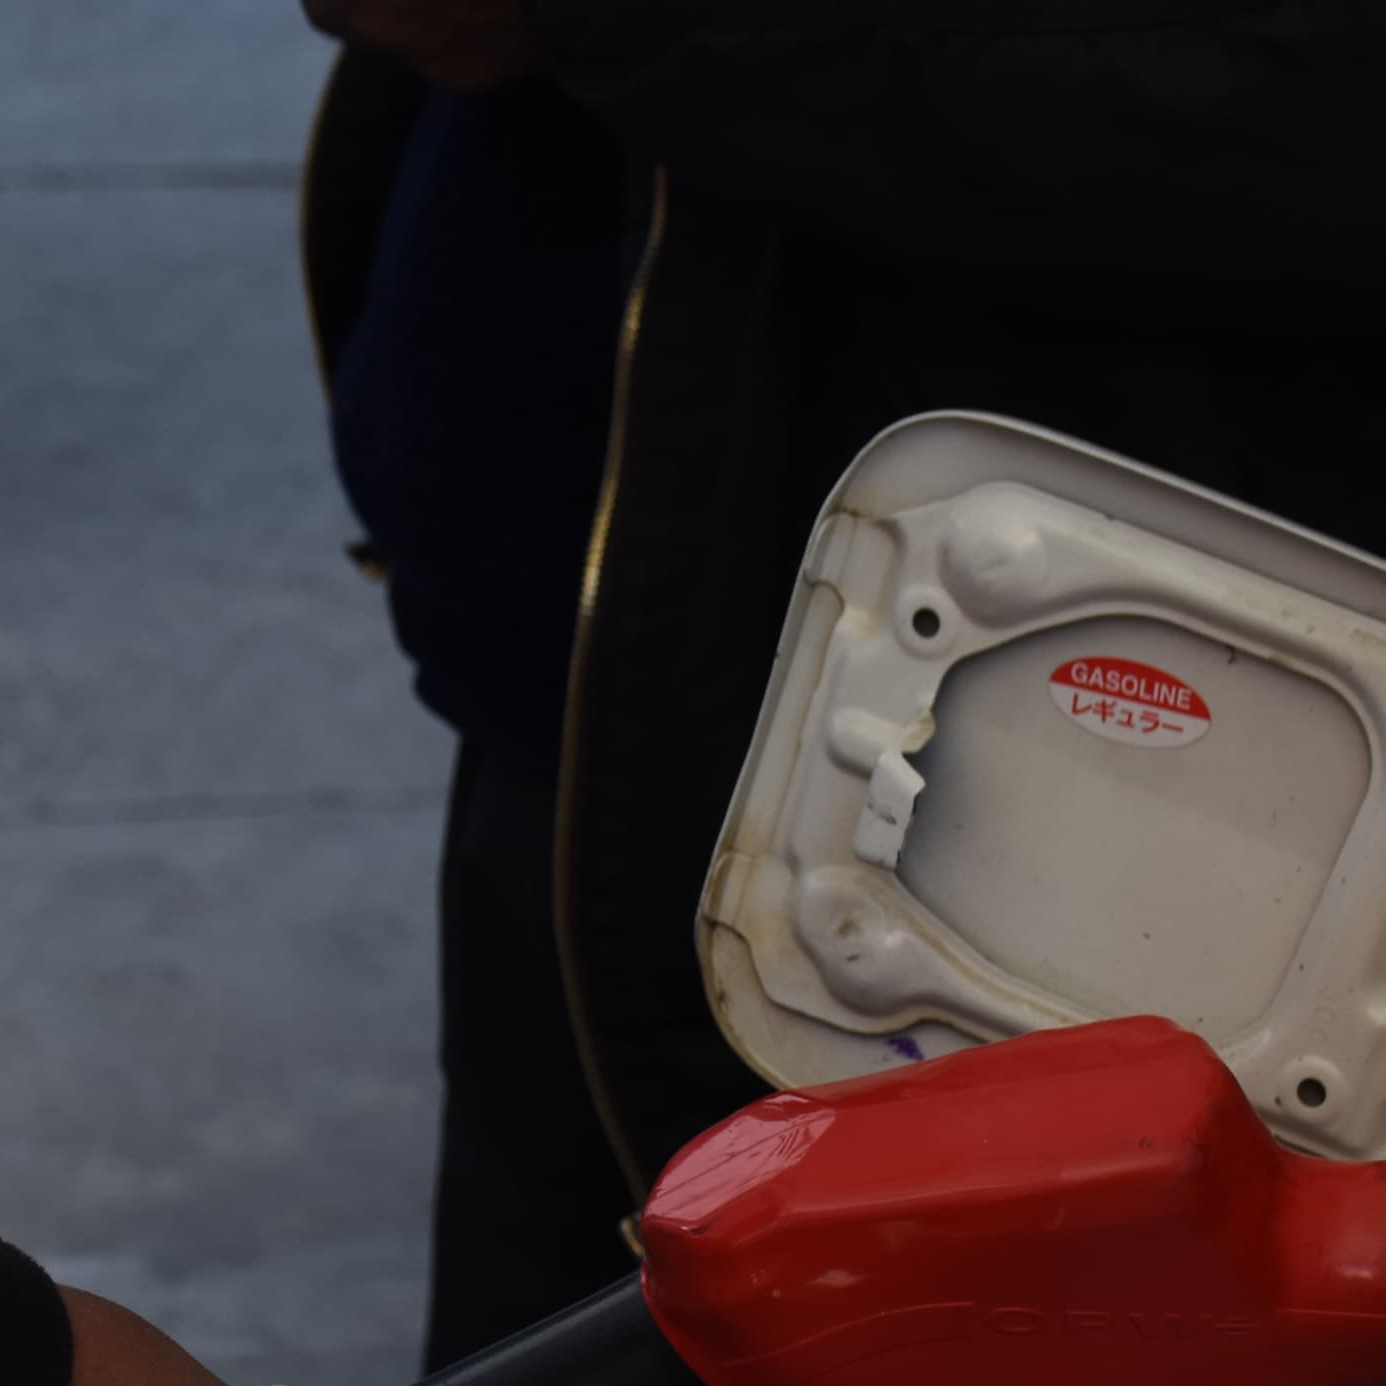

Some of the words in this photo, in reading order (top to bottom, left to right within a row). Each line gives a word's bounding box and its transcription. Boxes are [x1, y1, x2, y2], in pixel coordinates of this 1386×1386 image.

[1070, 661, 1192, 709] GASOLINE
[1071, 693, 1184, 733] レギュラー
